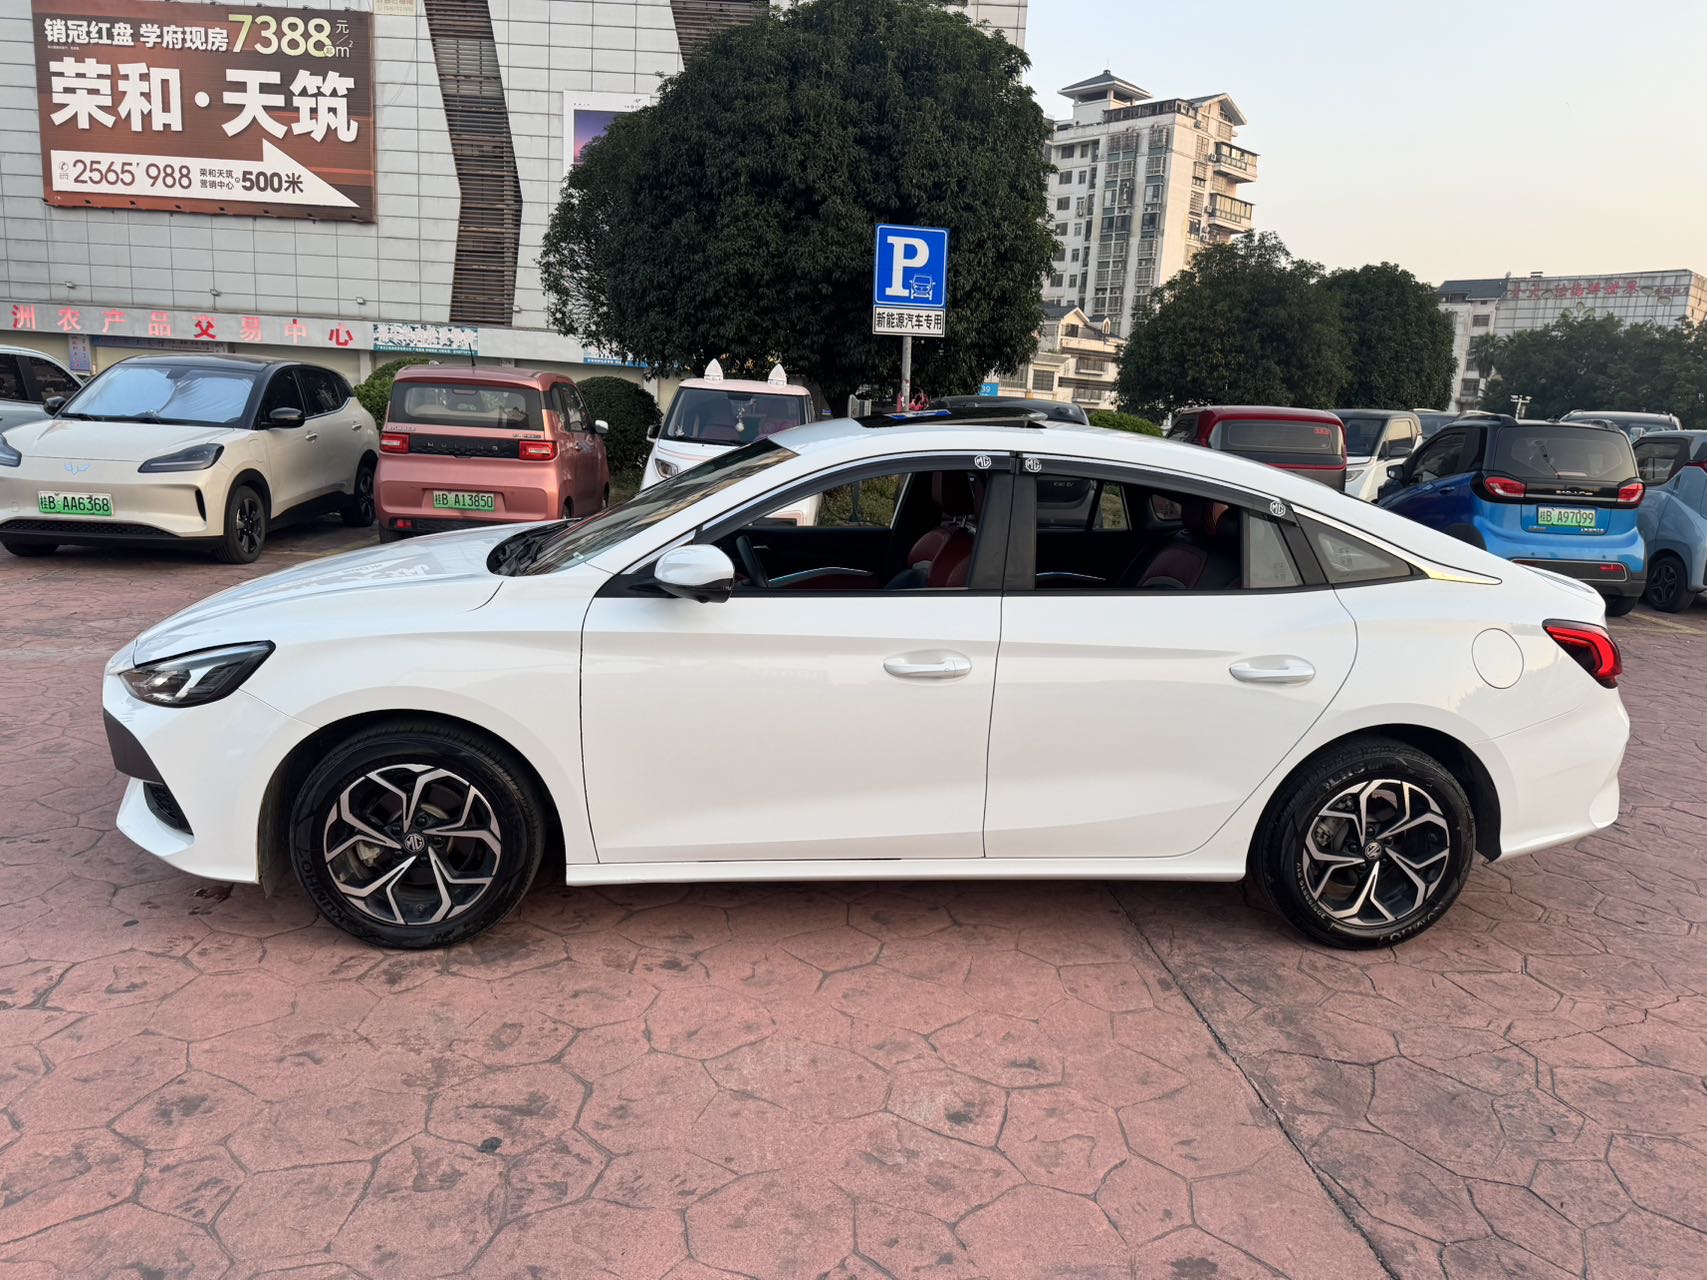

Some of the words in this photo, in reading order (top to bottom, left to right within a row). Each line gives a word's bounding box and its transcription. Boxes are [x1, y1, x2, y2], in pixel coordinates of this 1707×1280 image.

[44, 18, 135, 47] 销冠红盘
[139, 23, 229, 52] 学府现房
[228, 14, 334, 57] 7388
[199, 167, 234, 180] 荣和天筑
[199, 179, 235, 191] 营销中心
[241, 170, 304, 194] 500米
[885, 235, 930, 297] P
[11, 304, 355, 347] 洲农产品交易中心
[876, 312, 942, 330] 新能源汽车专用
[975, 455, 991, 469] MG
[1025, 458, 1041, 472] MG
[62, 496, 110, 512] AA6368
[454, 494, 493, 508] A13850
[1557, 511, 1594, 525] A97099
